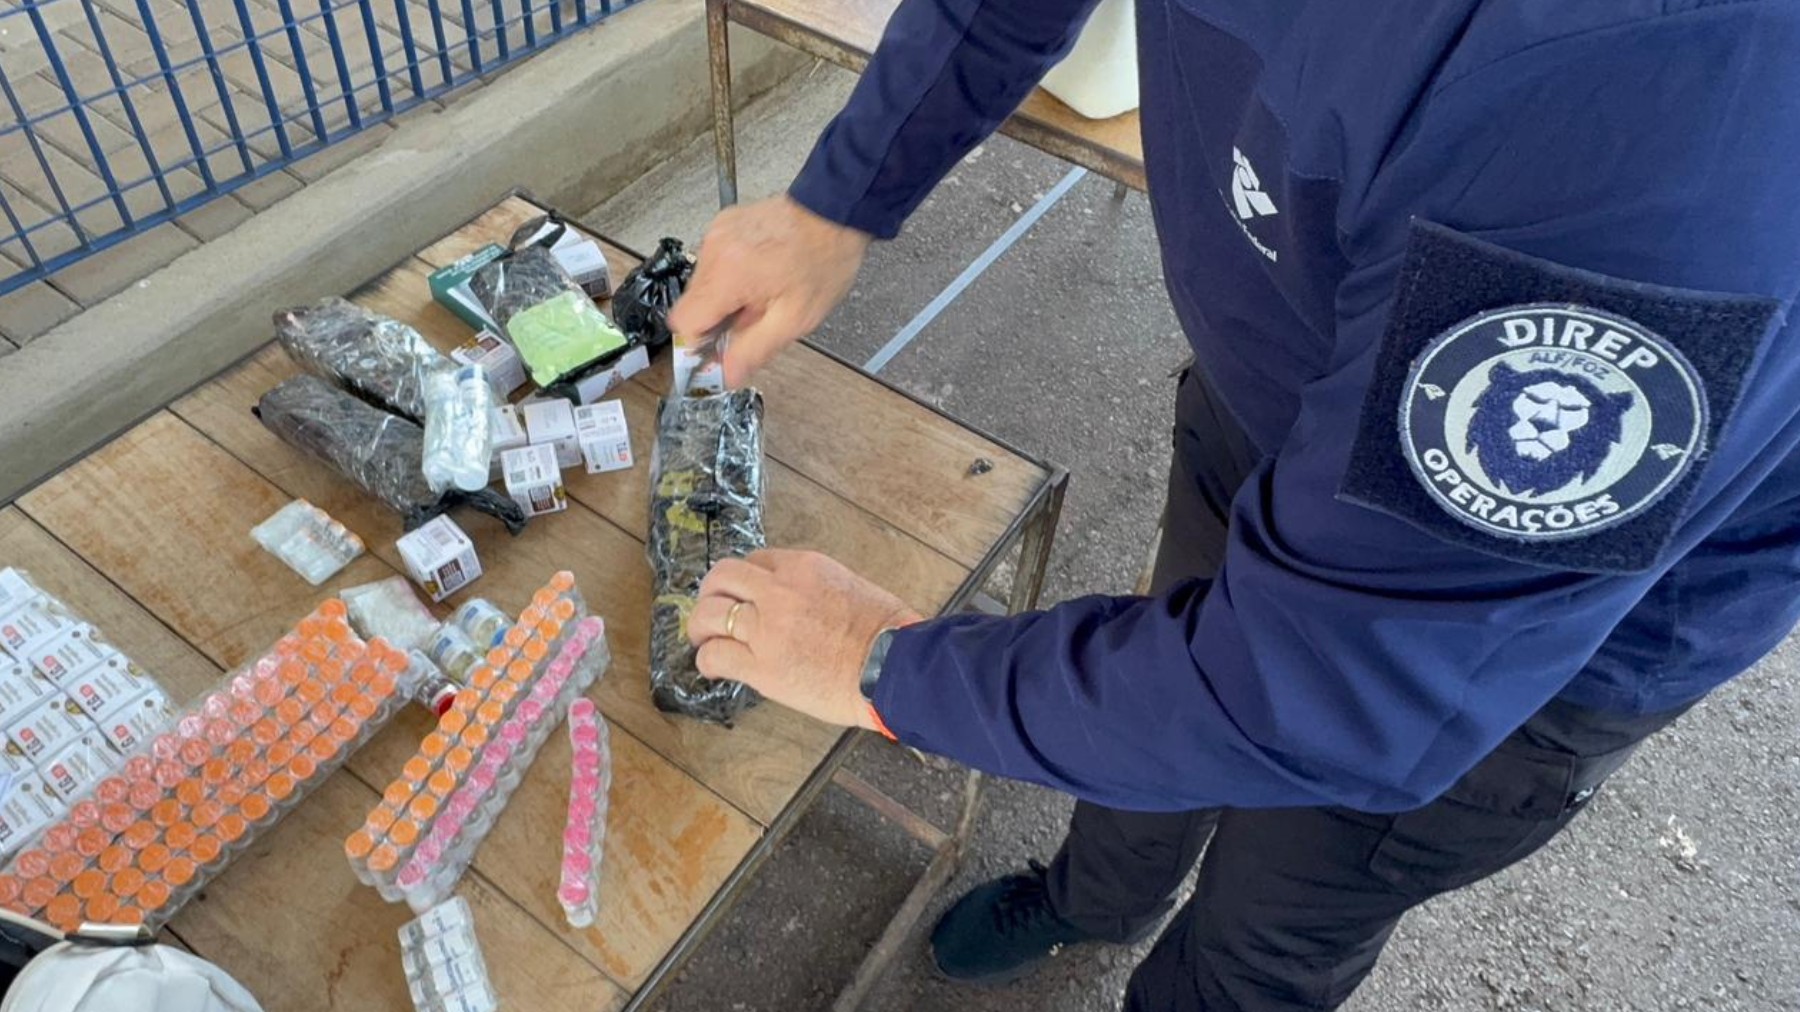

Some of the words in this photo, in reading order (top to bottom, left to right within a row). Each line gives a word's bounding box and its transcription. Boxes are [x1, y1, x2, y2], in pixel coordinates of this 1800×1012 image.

[1498, 318, 1659, 371] DIREP
[1528, 351, 1611, 381] ALF/FOZ
[1423, 447, 1620, 532] OPERAÇÕES
